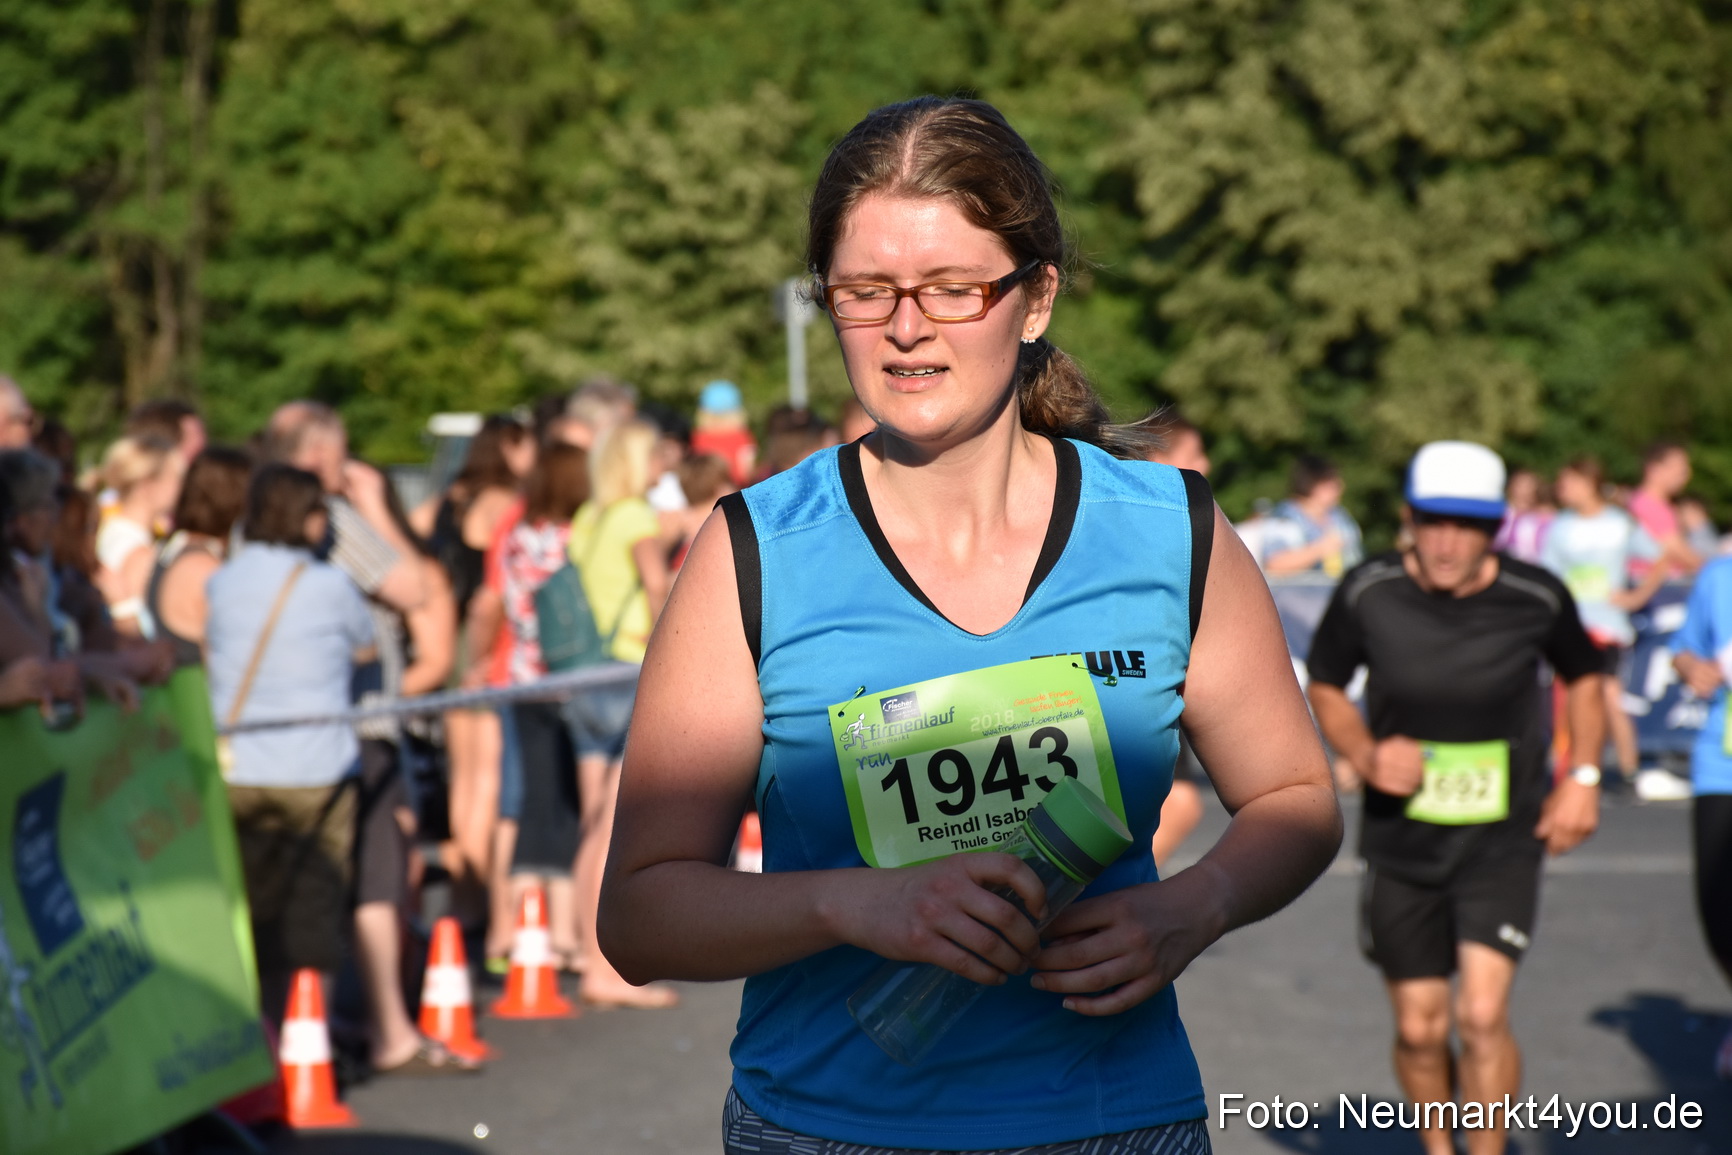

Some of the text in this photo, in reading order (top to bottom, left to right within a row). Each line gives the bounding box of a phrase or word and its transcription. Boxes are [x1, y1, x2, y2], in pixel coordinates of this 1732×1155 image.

[1030, 650, 1146, 678] ULE
[1047, 689, 1075, 703] Firmen
[870, 705, 956, 741] firmenlauf
[970, 709, 1015, 732] 2018
[880, 726, 1079, 826] 1943
[917, 815, 981, 843] Reindl
[951, 835, 989, 851] Thule
